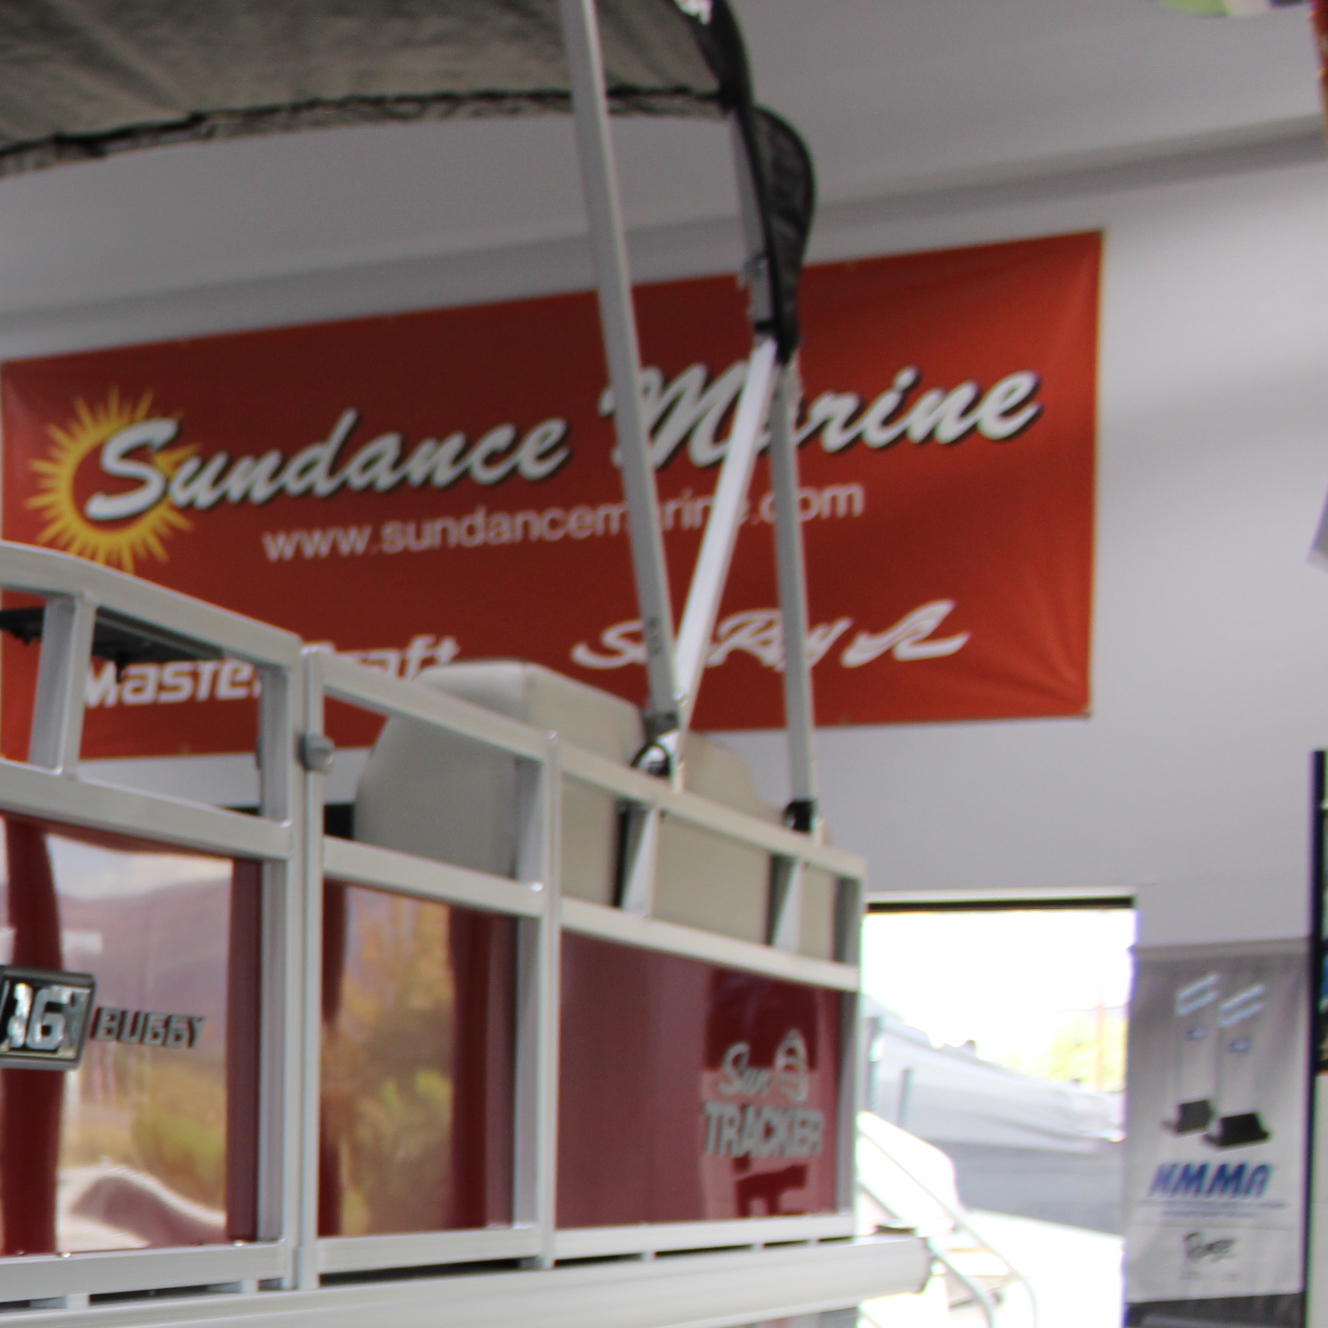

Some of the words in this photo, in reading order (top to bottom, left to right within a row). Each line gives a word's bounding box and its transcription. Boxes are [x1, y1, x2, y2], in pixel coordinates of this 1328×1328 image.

[85, 408, 572, 520] Sundance
[599, 358, 1042, 468] Mrine
[91, 1005, 206, 1050] BUGGY
[702, 1100, 825, 1158] TRACKER
